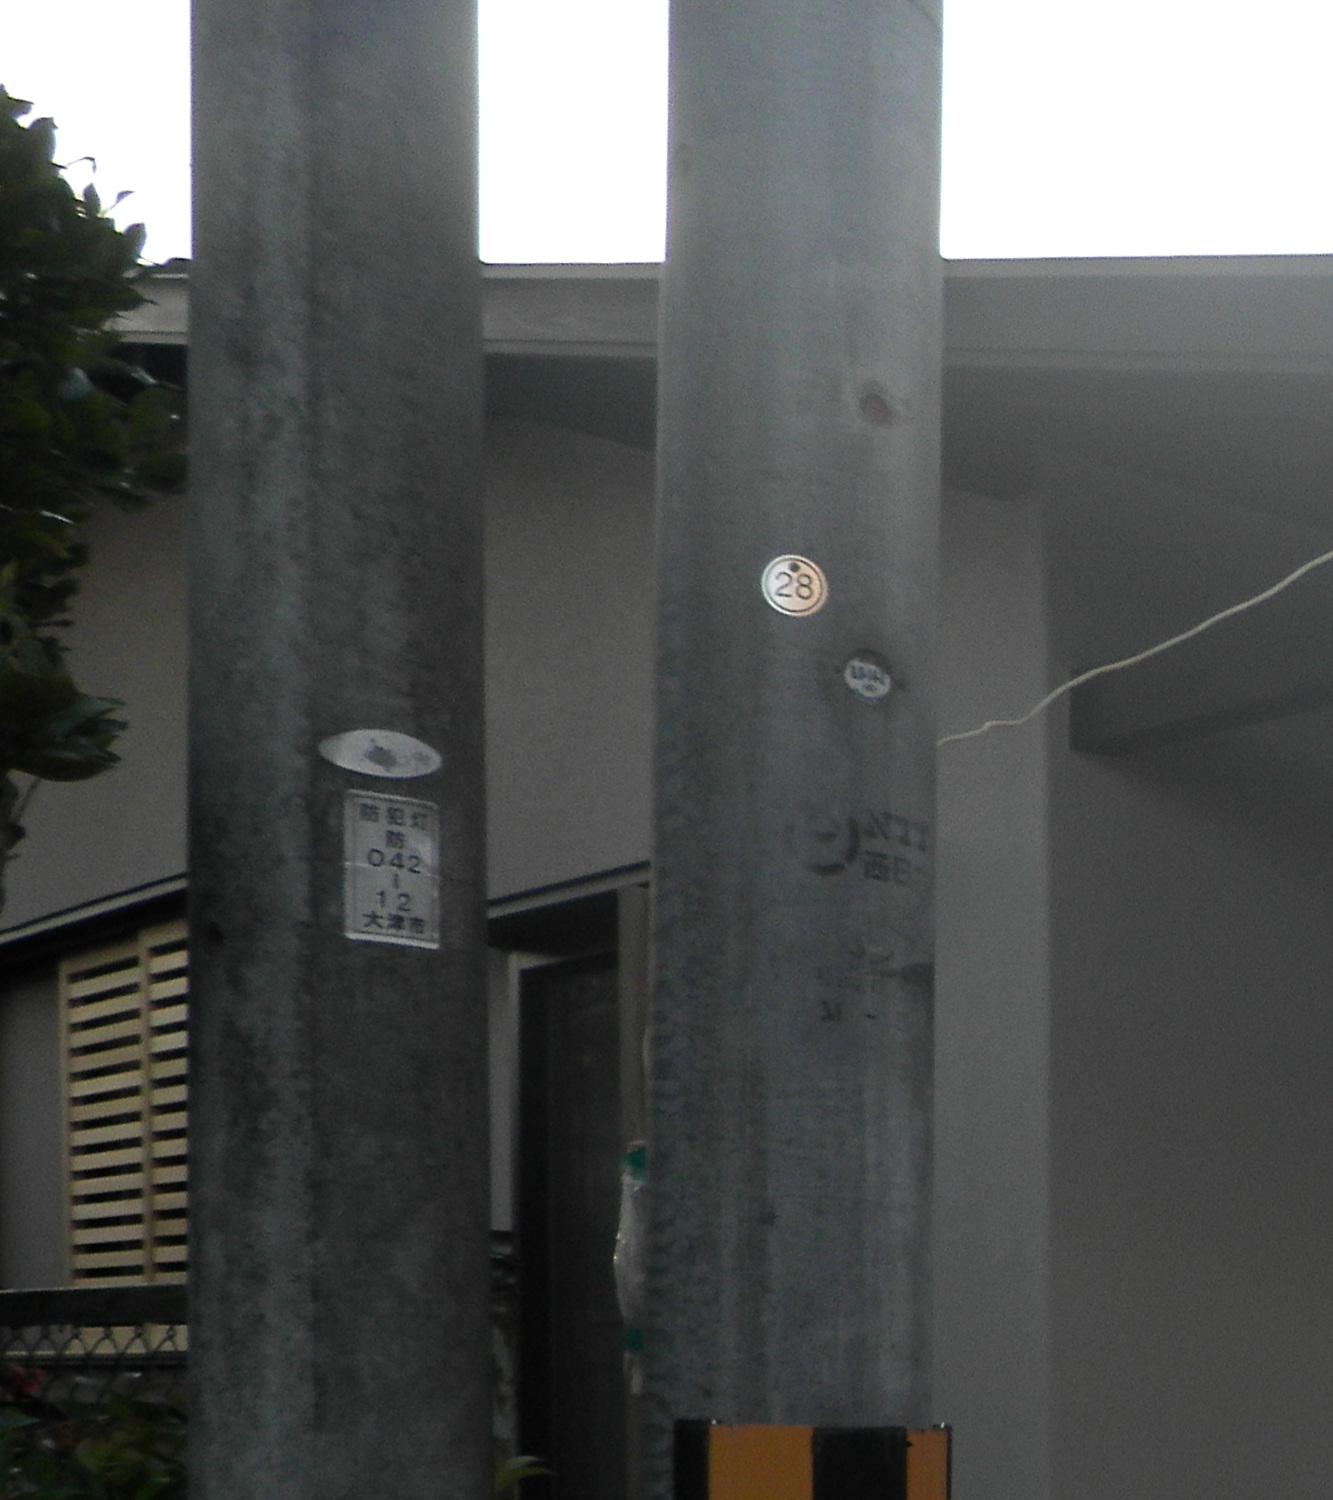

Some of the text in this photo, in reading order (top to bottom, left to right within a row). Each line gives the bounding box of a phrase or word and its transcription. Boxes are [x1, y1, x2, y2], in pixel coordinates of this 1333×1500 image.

[774, 571, 814, 600] 28
[366, 848, 421, 874] 042
[376, 890, 411, 912] 12
[363, 911, 425, 933] 大津市
